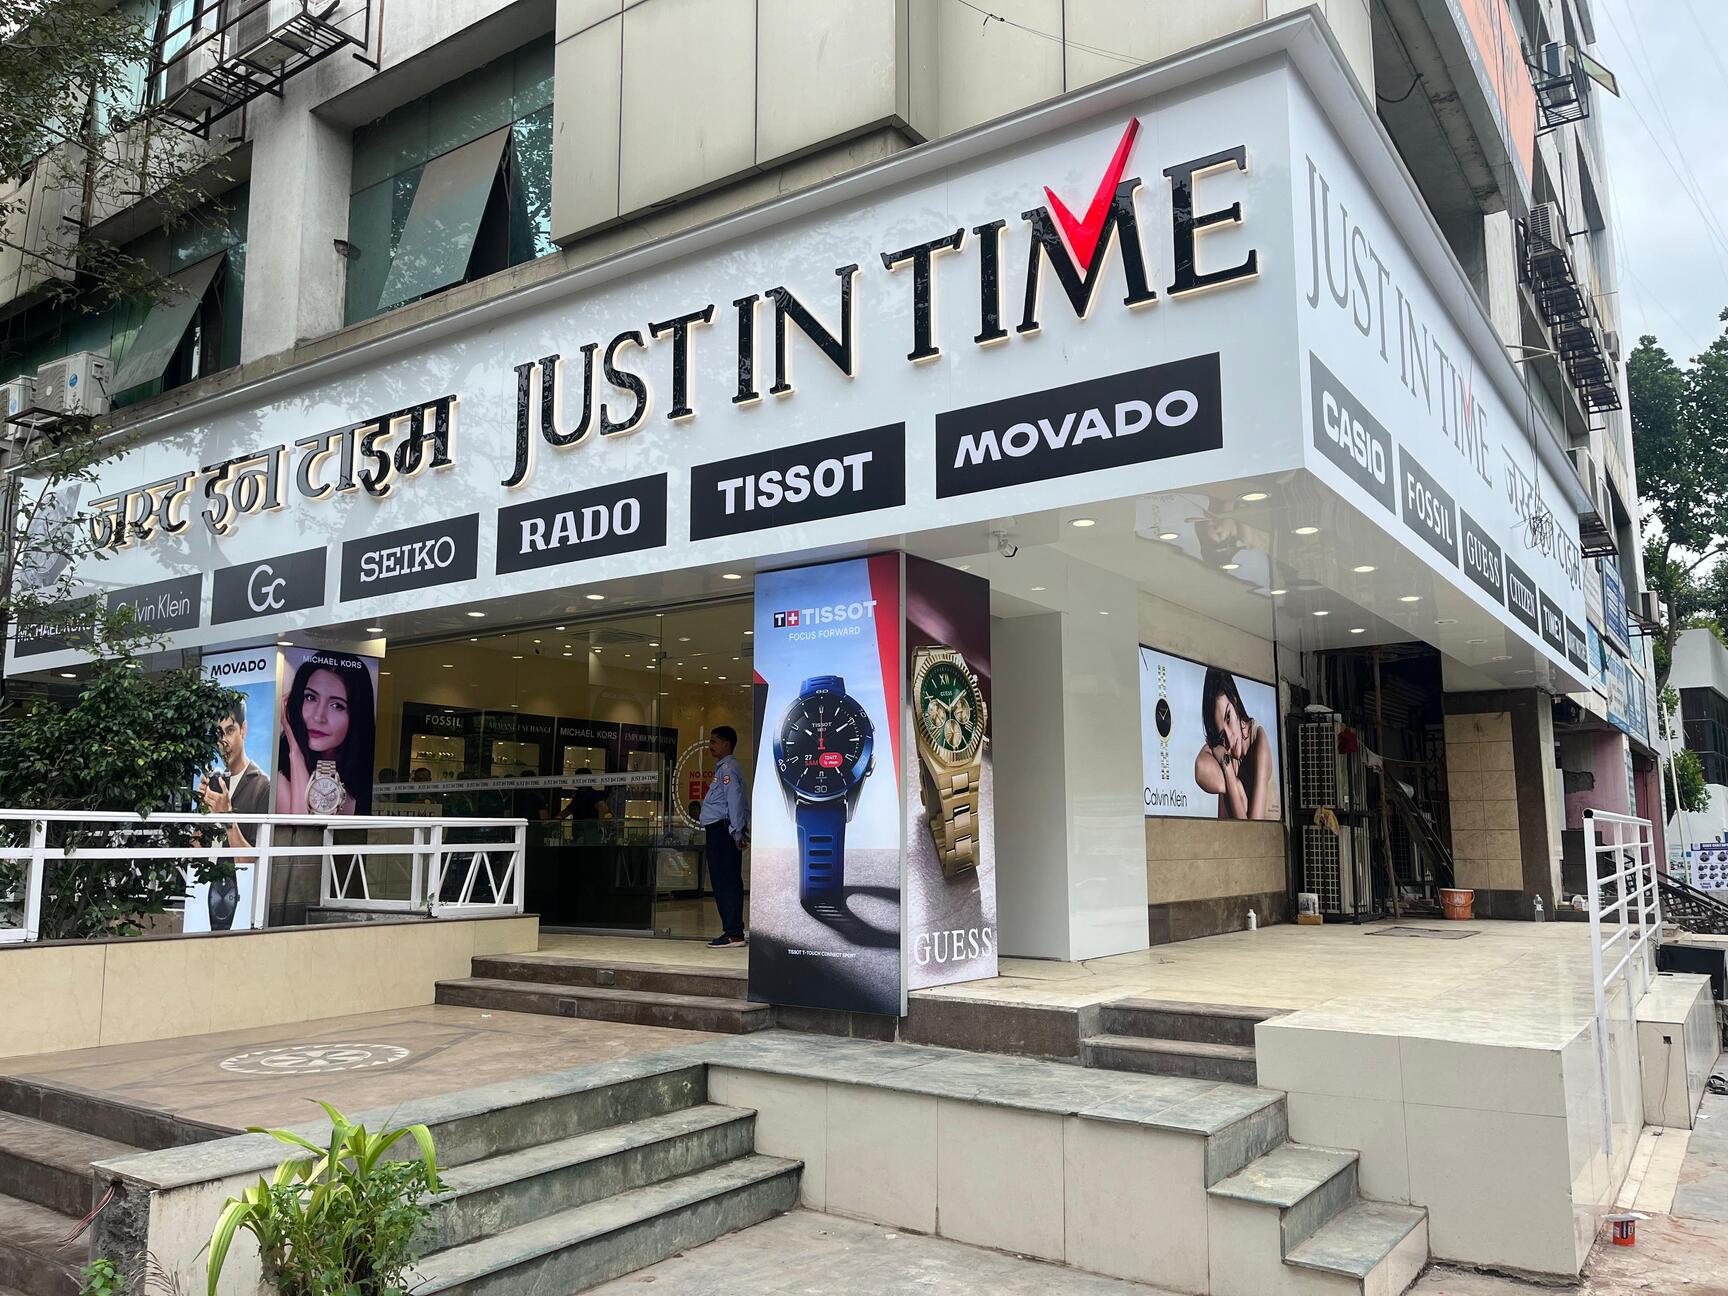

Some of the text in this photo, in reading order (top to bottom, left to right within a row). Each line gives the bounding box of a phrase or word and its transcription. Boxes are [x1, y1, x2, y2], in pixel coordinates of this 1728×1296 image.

[501, 145, 1259, 488] JUST IN TIME
[1305, 153, 1493, 488] JUST IN TIME
[953, 389, 1200, 470] MOVADO
[1322, 390, 1387, 485] CASIO
[88, 395, 457, 548] जस्ट इन टाइम
[717, 451, 874, 515] TISSOT
[518, 497, 642, 555] RADO
[1406, 471, 1453, 546] FOSSIL
[359, 535, 456, 583] SEIKO
[1466, 530, 1500, 588] GUESS
[116, 591, 191, 626] Clvin Klein
[801, 600, 877, 625] TISSOT
[1509, 573, 1536, 619] CITIZEN
[788, 626, 861, 641] FOCUS FORWARD
[210, 658, 267, 678] MOVADO
[302, 655, 362, 669] MICHAEL KORS
[425, 714, 462, 728] FOSSIL
[560, 727, 618, 740] MICHAEL KORS
[814, 785, 828, 793] 30
[1143, 787, 1188, 807] Calvin Klein
[913, 927, 993, 965] GUESS
